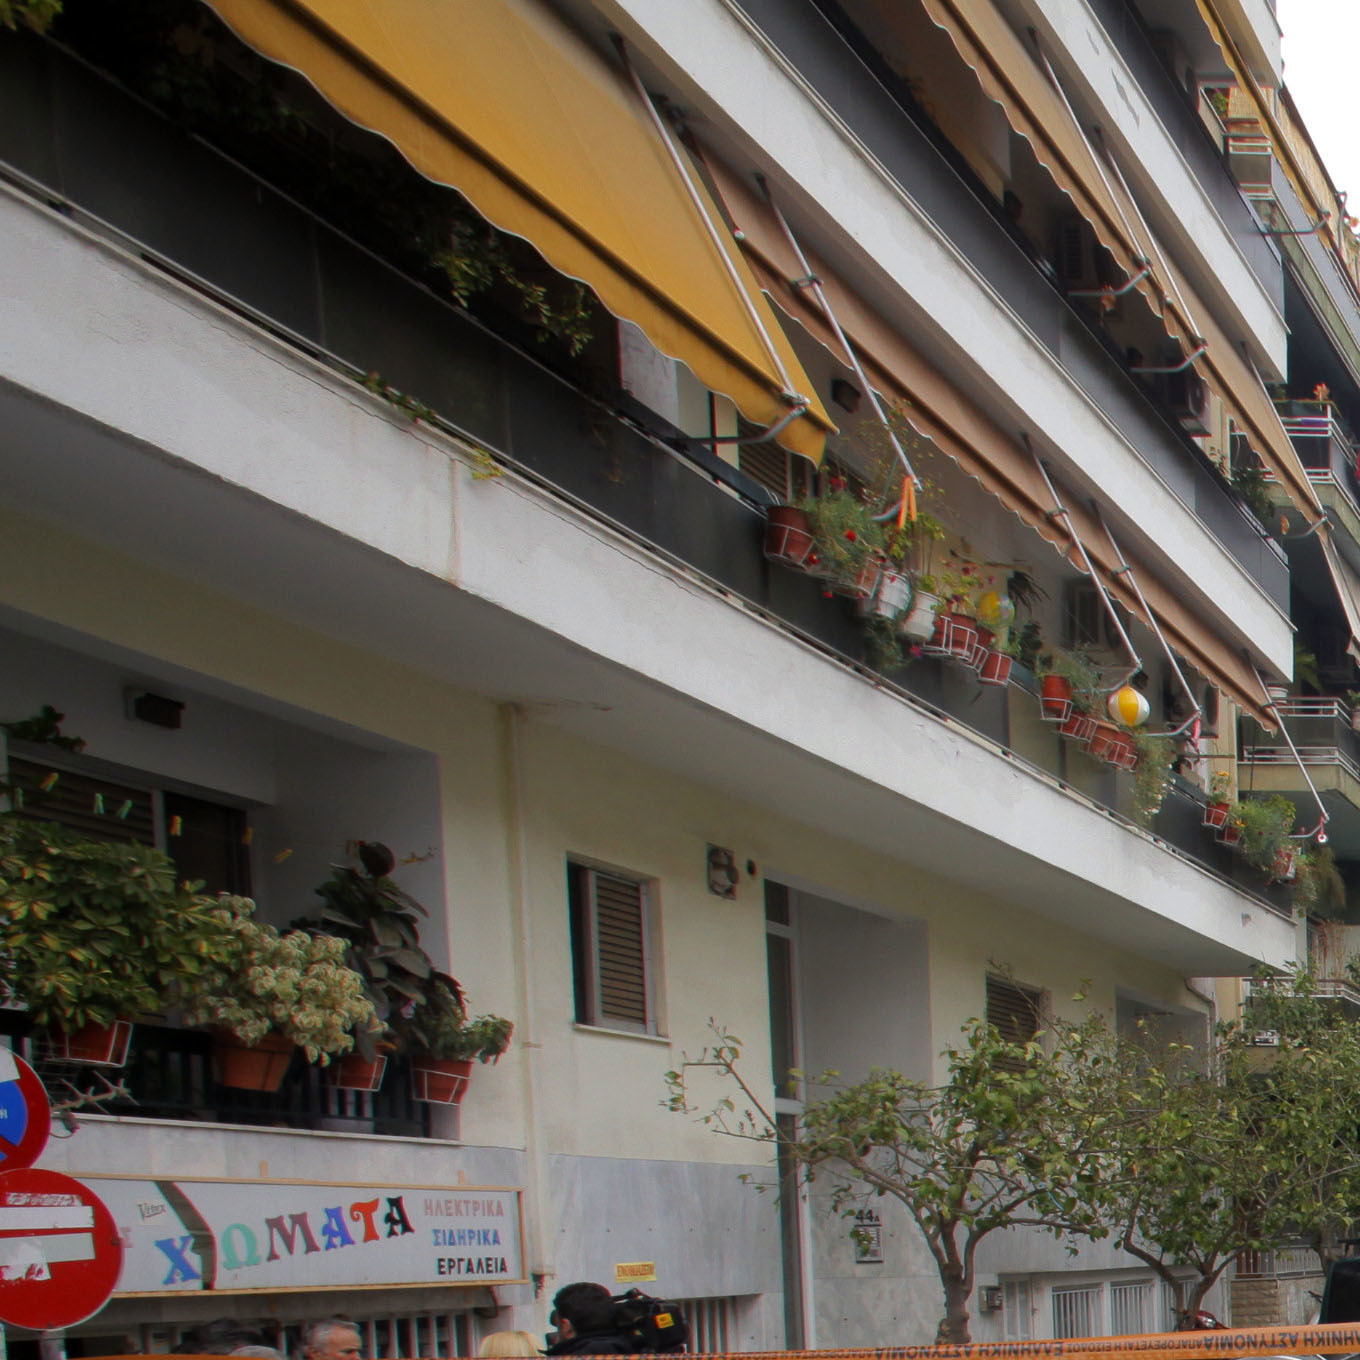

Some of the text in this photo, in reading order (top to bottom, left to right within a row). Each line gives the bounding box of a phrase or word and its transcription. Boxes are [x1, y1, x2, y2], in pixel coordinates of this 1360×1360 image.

[423, 1197, 505, 1217] ΗΛΕΚΤΡΙΚΑ
[431, 1228, 502, 1247] ΣΙΔΗΡΙΚΑ
[436, 1256, 509, 1276] ΕΡΓΑΛΕΙΑ
[978, 1341, 1063, 1357] ΕΛΛΗΝΙΚΗ
[1065, 1341, 1112, 1353] ΕΙΣΟΔΟΣ
[1124, 1337, 1203, 1351] ΑΠΑΓΟΡΕΥΕΤΑΙ
[1203, 1332, 1299, 1351] ΑΣΤΥΝΟΜΙΑ
[874, 1344, 973, 1360] ΑΣΤΥΝΟΜΙΑ
